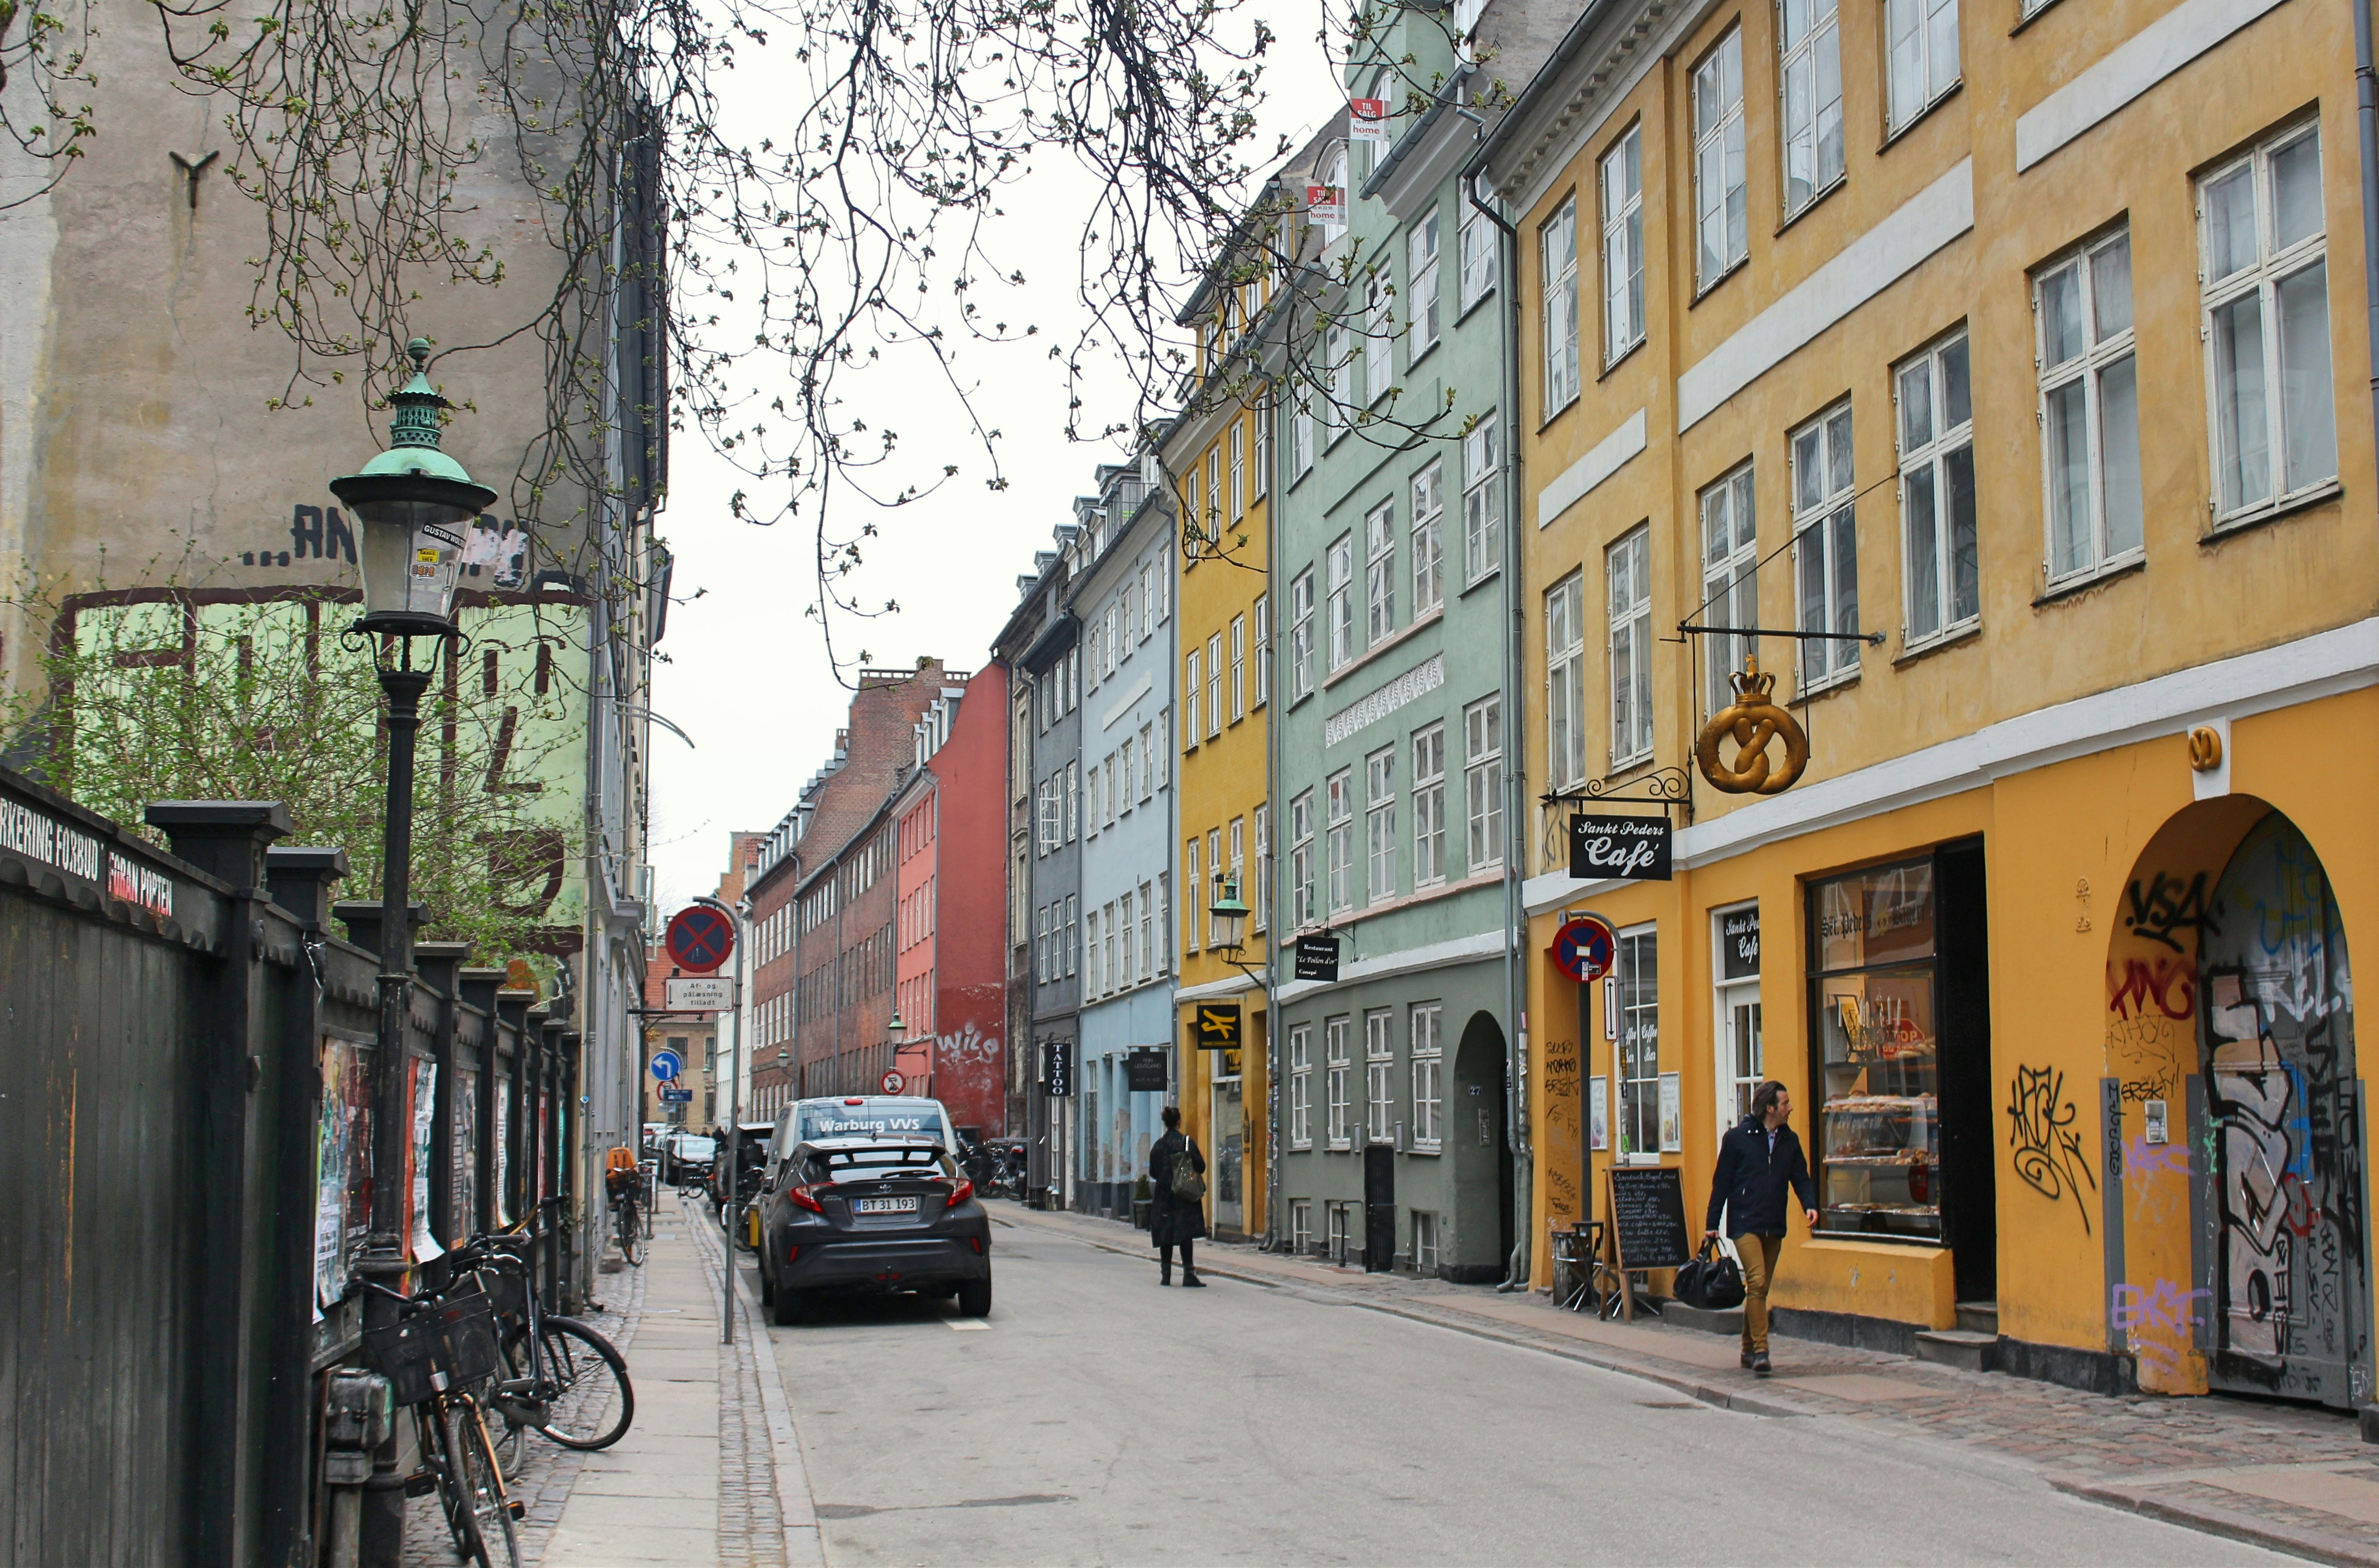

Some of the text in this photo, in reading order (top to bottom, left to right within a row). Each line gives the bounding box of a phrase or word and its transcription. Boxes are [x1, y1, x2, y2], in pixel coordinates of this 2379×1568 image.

[1357, 110, 1376, 118] SALG
[1353, 124, 1380, 134] home
[1310, 210, 1335, 218] home
[424, 525, 450, 540] GUSTAV
[1578, 821, 1664, 835] Sankt Peders
[56, 823, 98, 881] FORBUD
[1585, 836, 1659, 876] Café
[1726, 919, 1746, 935] Sankt
[1641, 1024, 1657, 1043] Coffee
[1644, 1046, 1656, 1062] Bar
[1053, 1045, 1063, 1094] TATTOO
[1470, 1086, 1480, 1095] 27
[819, 1118, 920, 1132] Warburg VVS
[862, 1199, 915, 1211] BT 31 193
